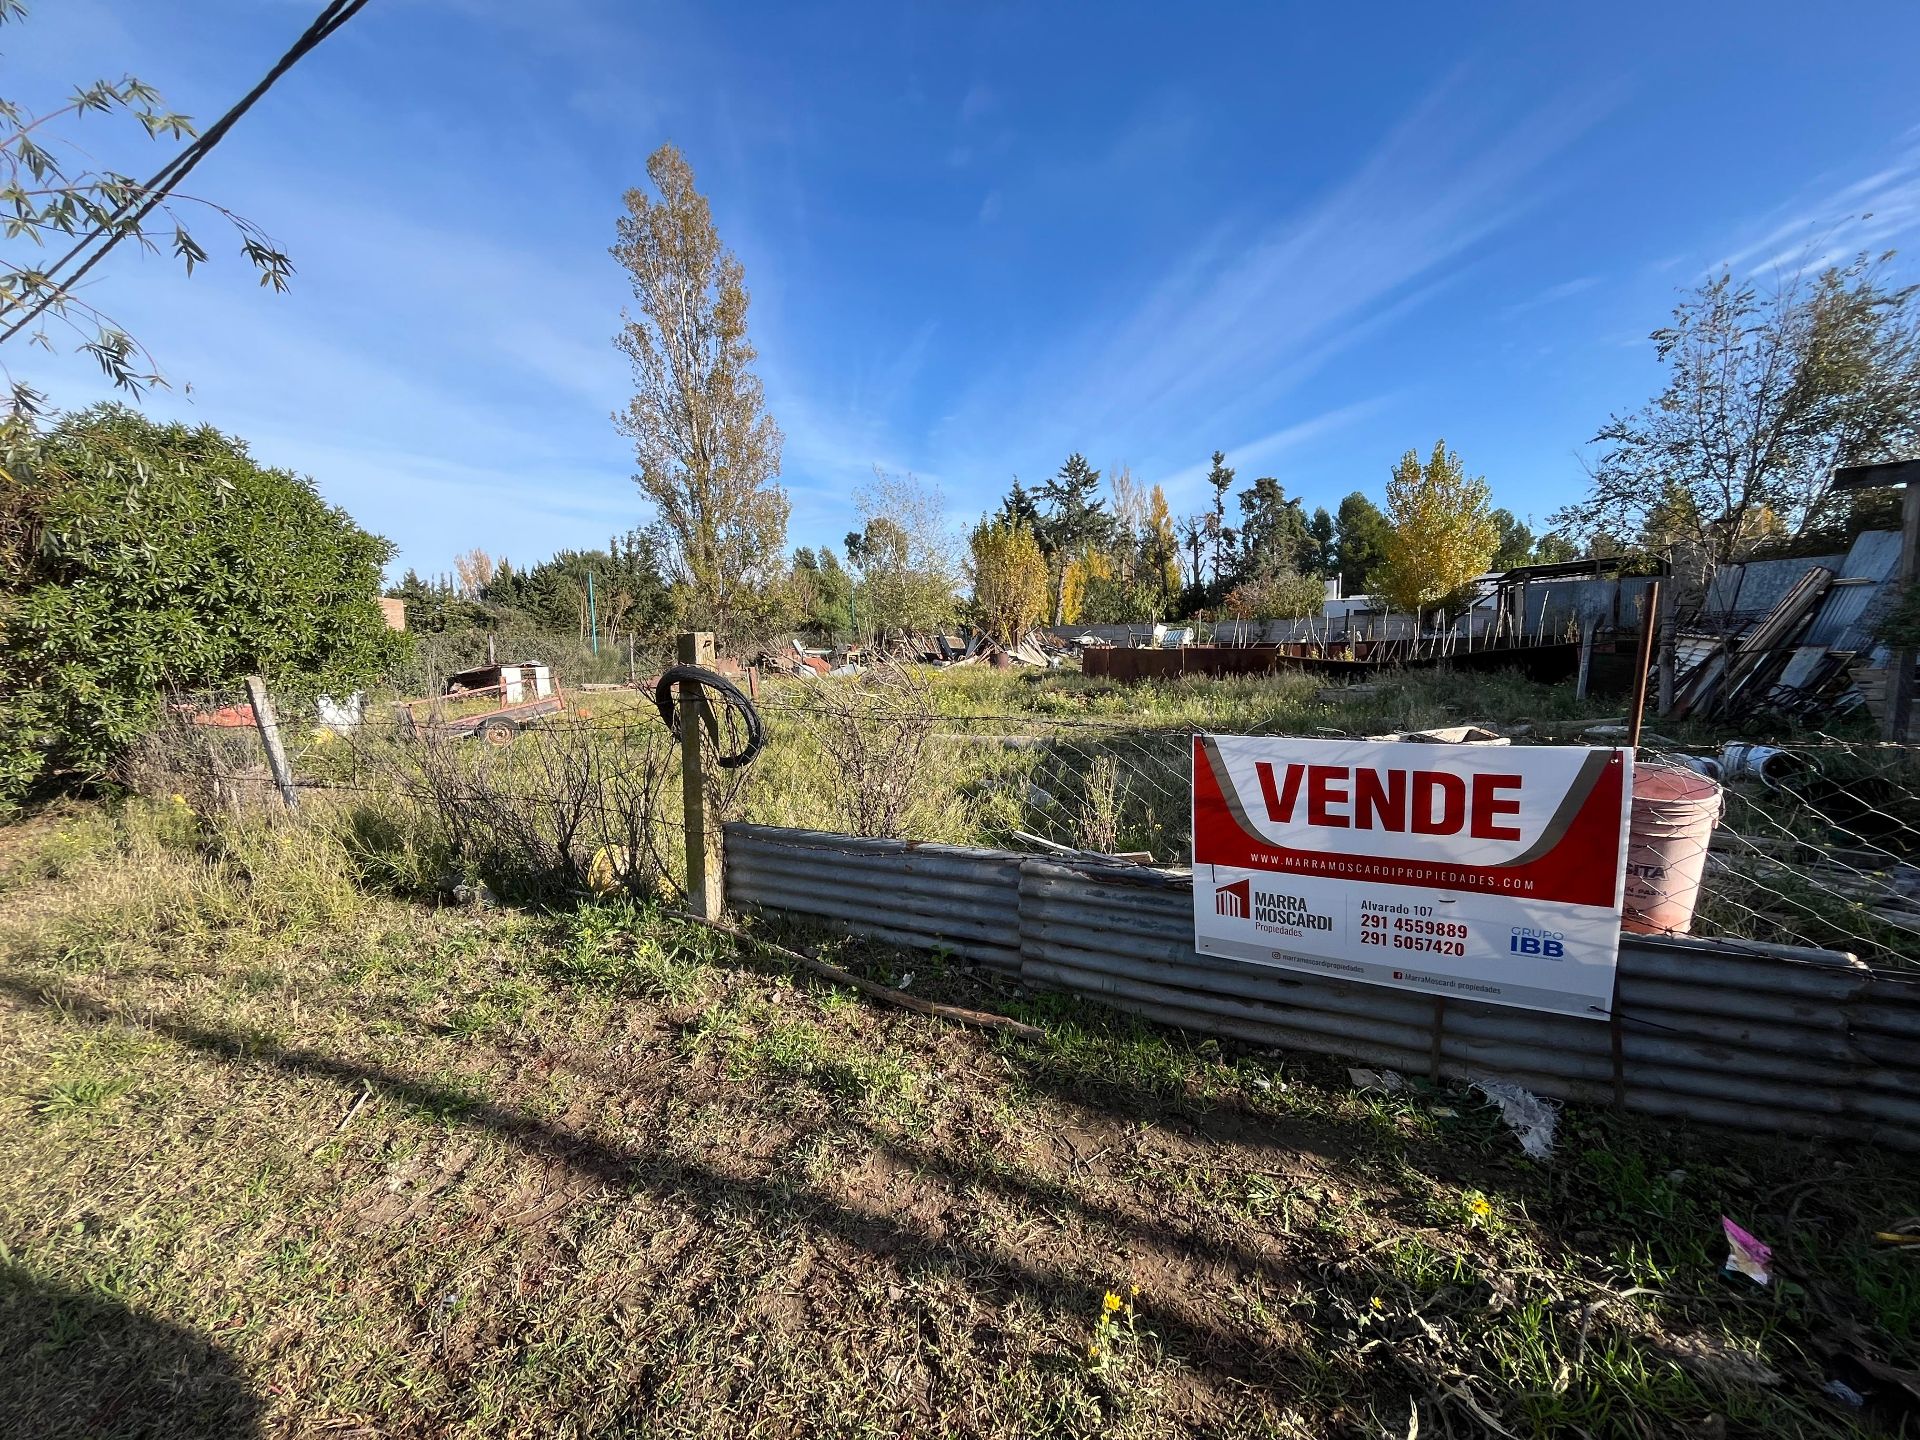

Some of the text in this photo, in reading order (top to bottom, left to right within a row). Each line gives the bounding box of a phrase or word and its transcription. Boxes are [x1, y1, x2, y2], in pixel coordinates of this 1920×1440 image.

[1255, 762, 1522, 841] VENDE
[1250, 853, 1533, 890] WWW.MARRAMOSCARDIPROPIEDADES.COM
[1255, 891, 1307, 912] MARRA
[1361, 900, 1433, 917] Alvarado 107
[1255, 907, 1332, 931] MOSCARDI
[1361, 913, 1468, 939] 291 4559889
[1361, 930, 1465, 957] 291 5057420
[1511, 926, 1564, 941] GRUPO
[1511, 935, 1564, 957] IBB
[1405, 973, 1502, 995] MarraMoscardi propiedades
